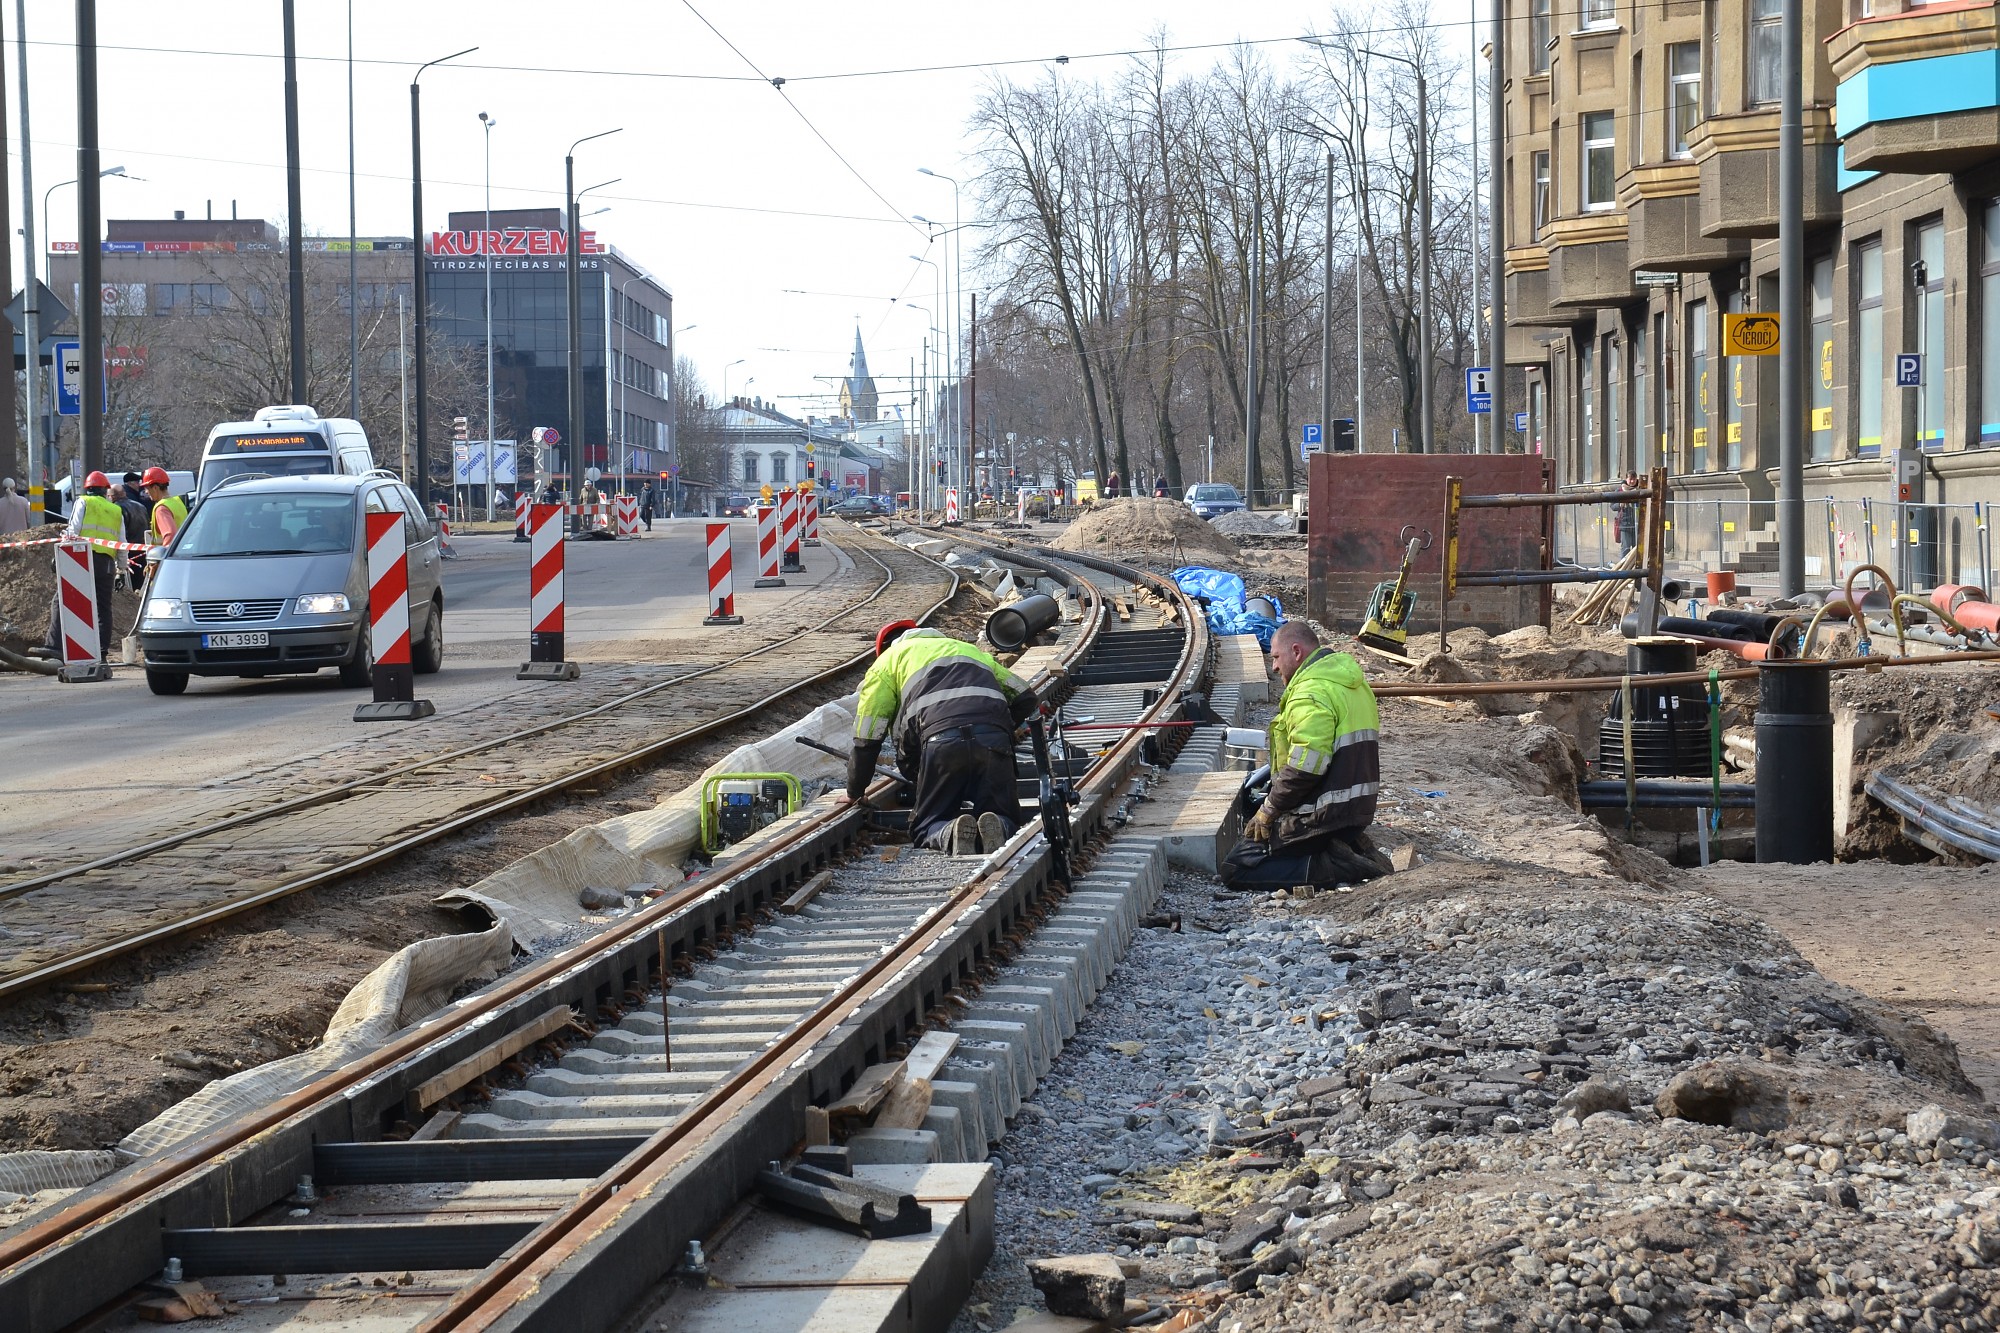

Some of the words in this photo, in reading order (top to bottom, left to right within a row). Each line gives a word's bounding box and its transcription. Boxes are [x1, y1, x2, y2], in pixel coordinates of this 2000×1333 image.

[432, 230, 597, 256] KURZEME
[558, 261, 598, 269] NMS
[1900, 358, 1917, 381] P
[1307, 426, 1318, 441] P
[1901, 460, 1921, 484] P
[211, 635, 267, 646] KN-3999
